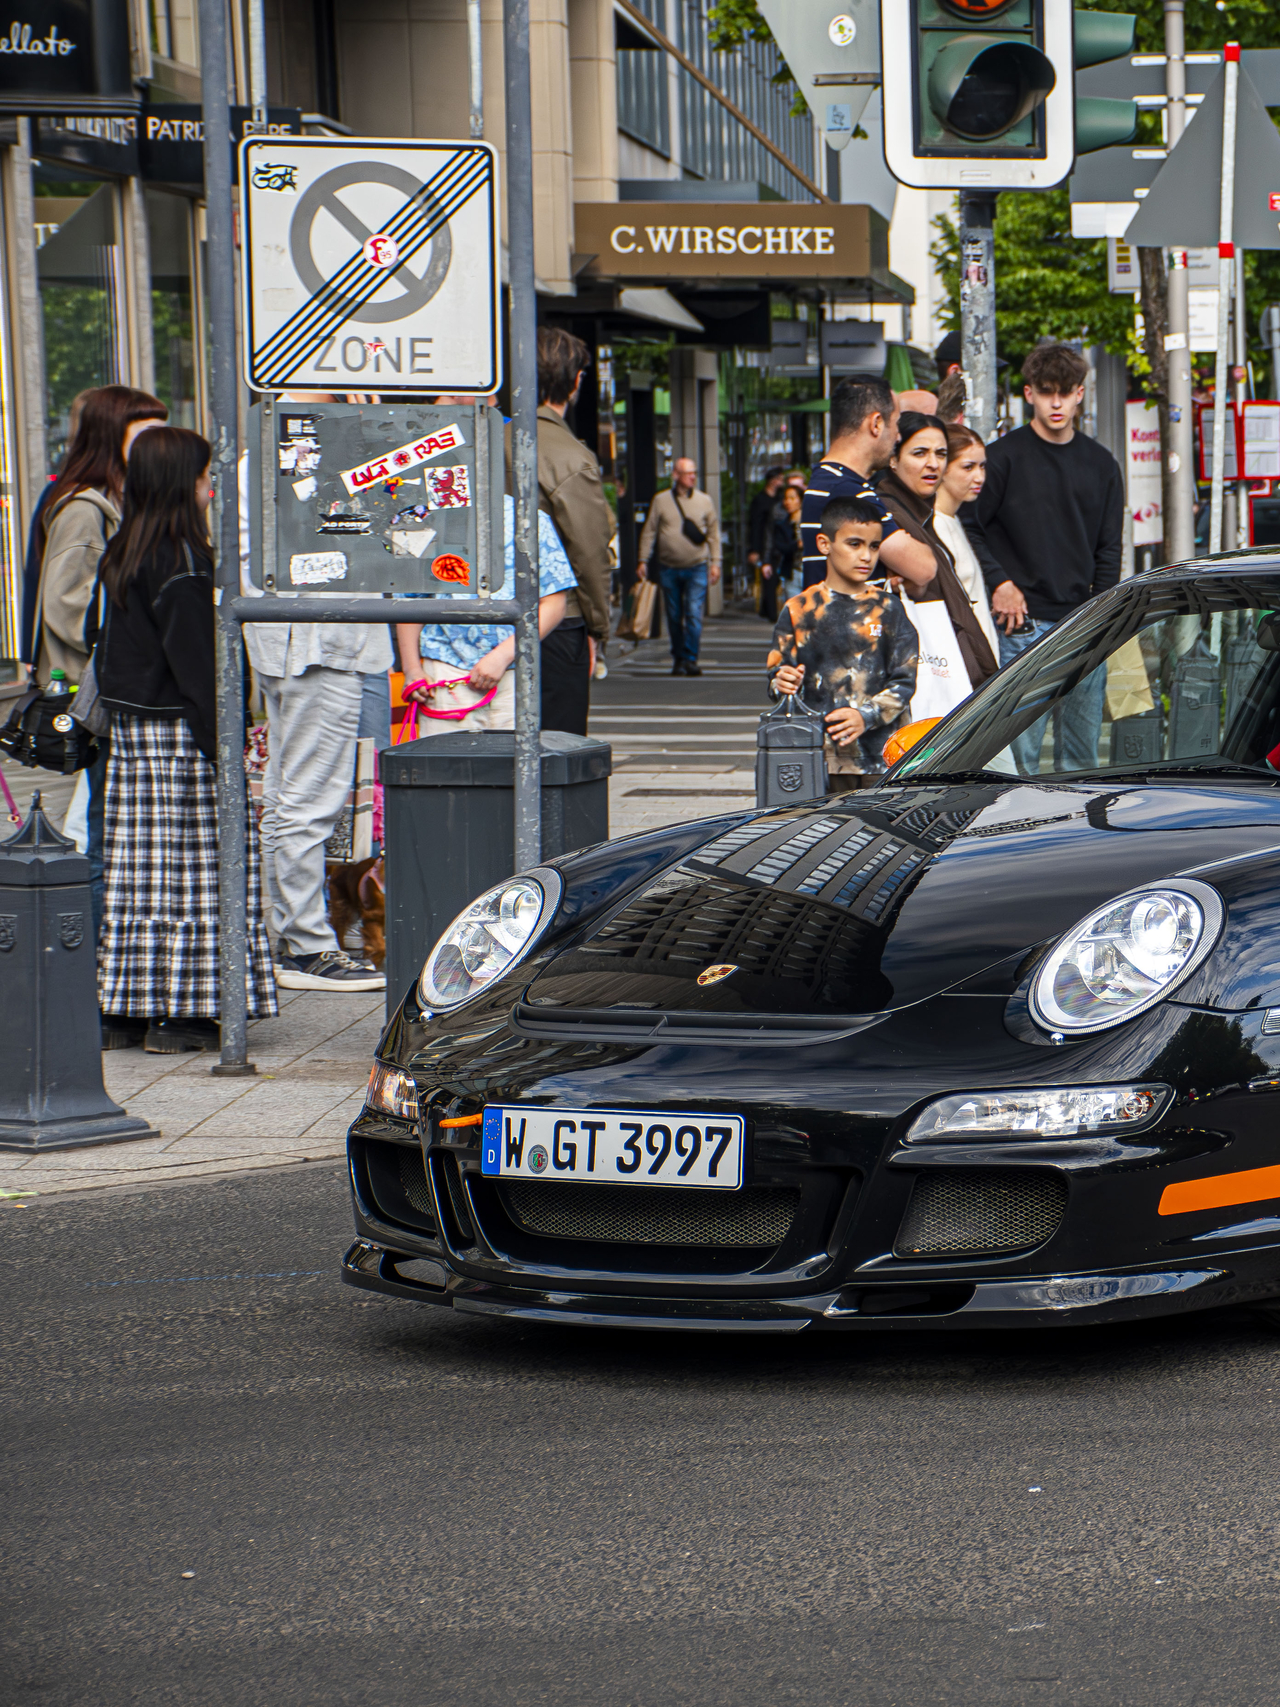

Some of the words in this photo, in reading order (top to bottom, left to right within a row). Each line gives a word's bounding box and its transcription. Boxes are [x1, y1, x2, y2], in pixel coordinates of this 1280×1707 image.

[242, 120, 293, 135] PPE
[610, 225, 835, 255] C.WIRSCHKE
[313, 335, 435, 375] ZONE
[487, 1148, 496, 1165] D
[504, 1116, 528, 1169] W
[552, 1119, 607, 1173] GT
[615, 1121, 734, 1178] 3997
